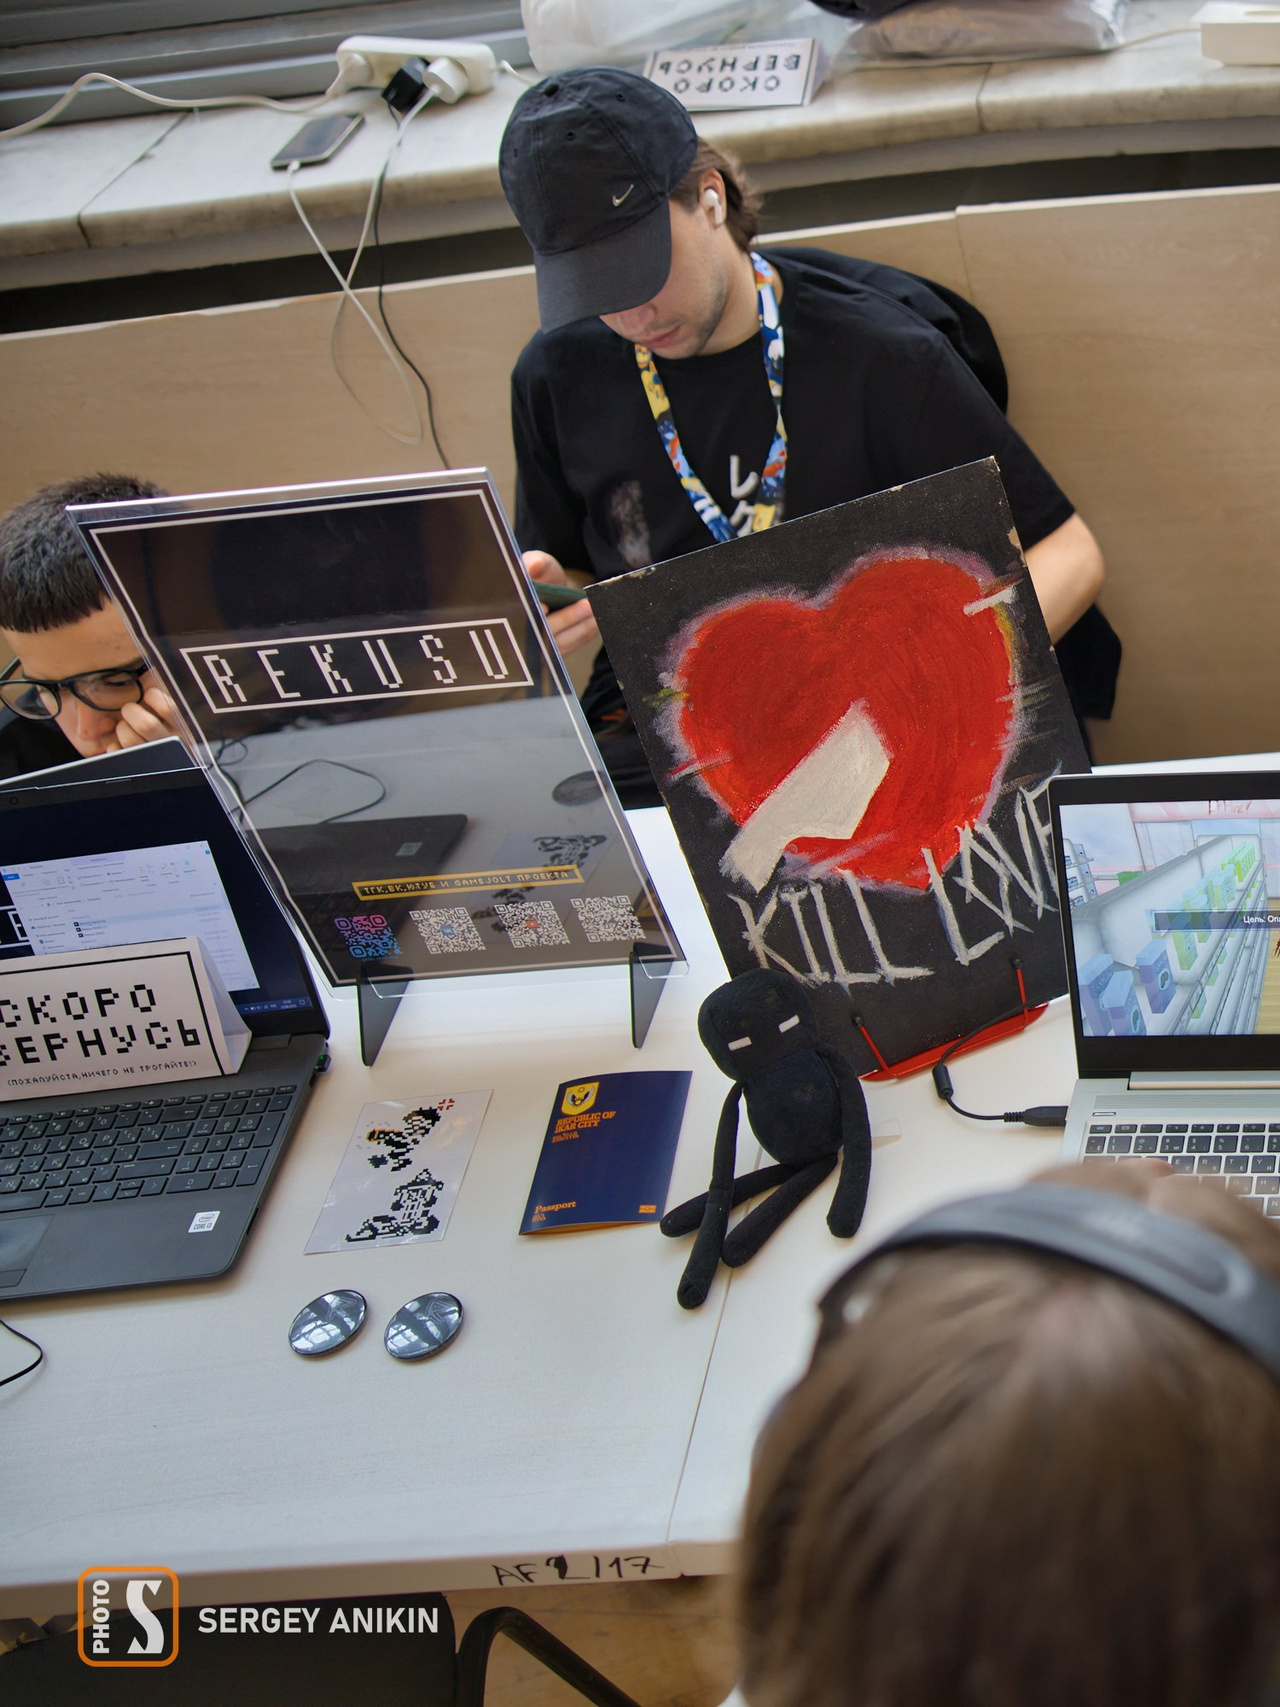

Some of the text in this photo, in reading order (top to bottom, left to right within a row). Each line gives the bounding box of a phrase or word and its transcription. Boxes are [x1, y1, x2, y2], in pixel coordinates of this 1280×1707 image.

[659, 54, 801, 75] ВЕРНУСЬ
[674, 75, 780, 94] СКОРО
[202, 629, 509, 704] REKUSU
[440, 880, 450, 888] И
[516, 871, 569, 882] ПРОЕКТА
[727, 867, 936, 990] KILL
[1243, 915, 1266, 924] Цель:
[0, 983, 157, 1029] СКОРО
[122, 1066, 135, 1075] НЕ
[554, 1119, 601, 1134] IKAR CITY
[556, 1110, 617, 1127] REPUBLIC OF
[534, 1200, 577, 1214] Passport
[491, 1563, 537, 1587] AF
